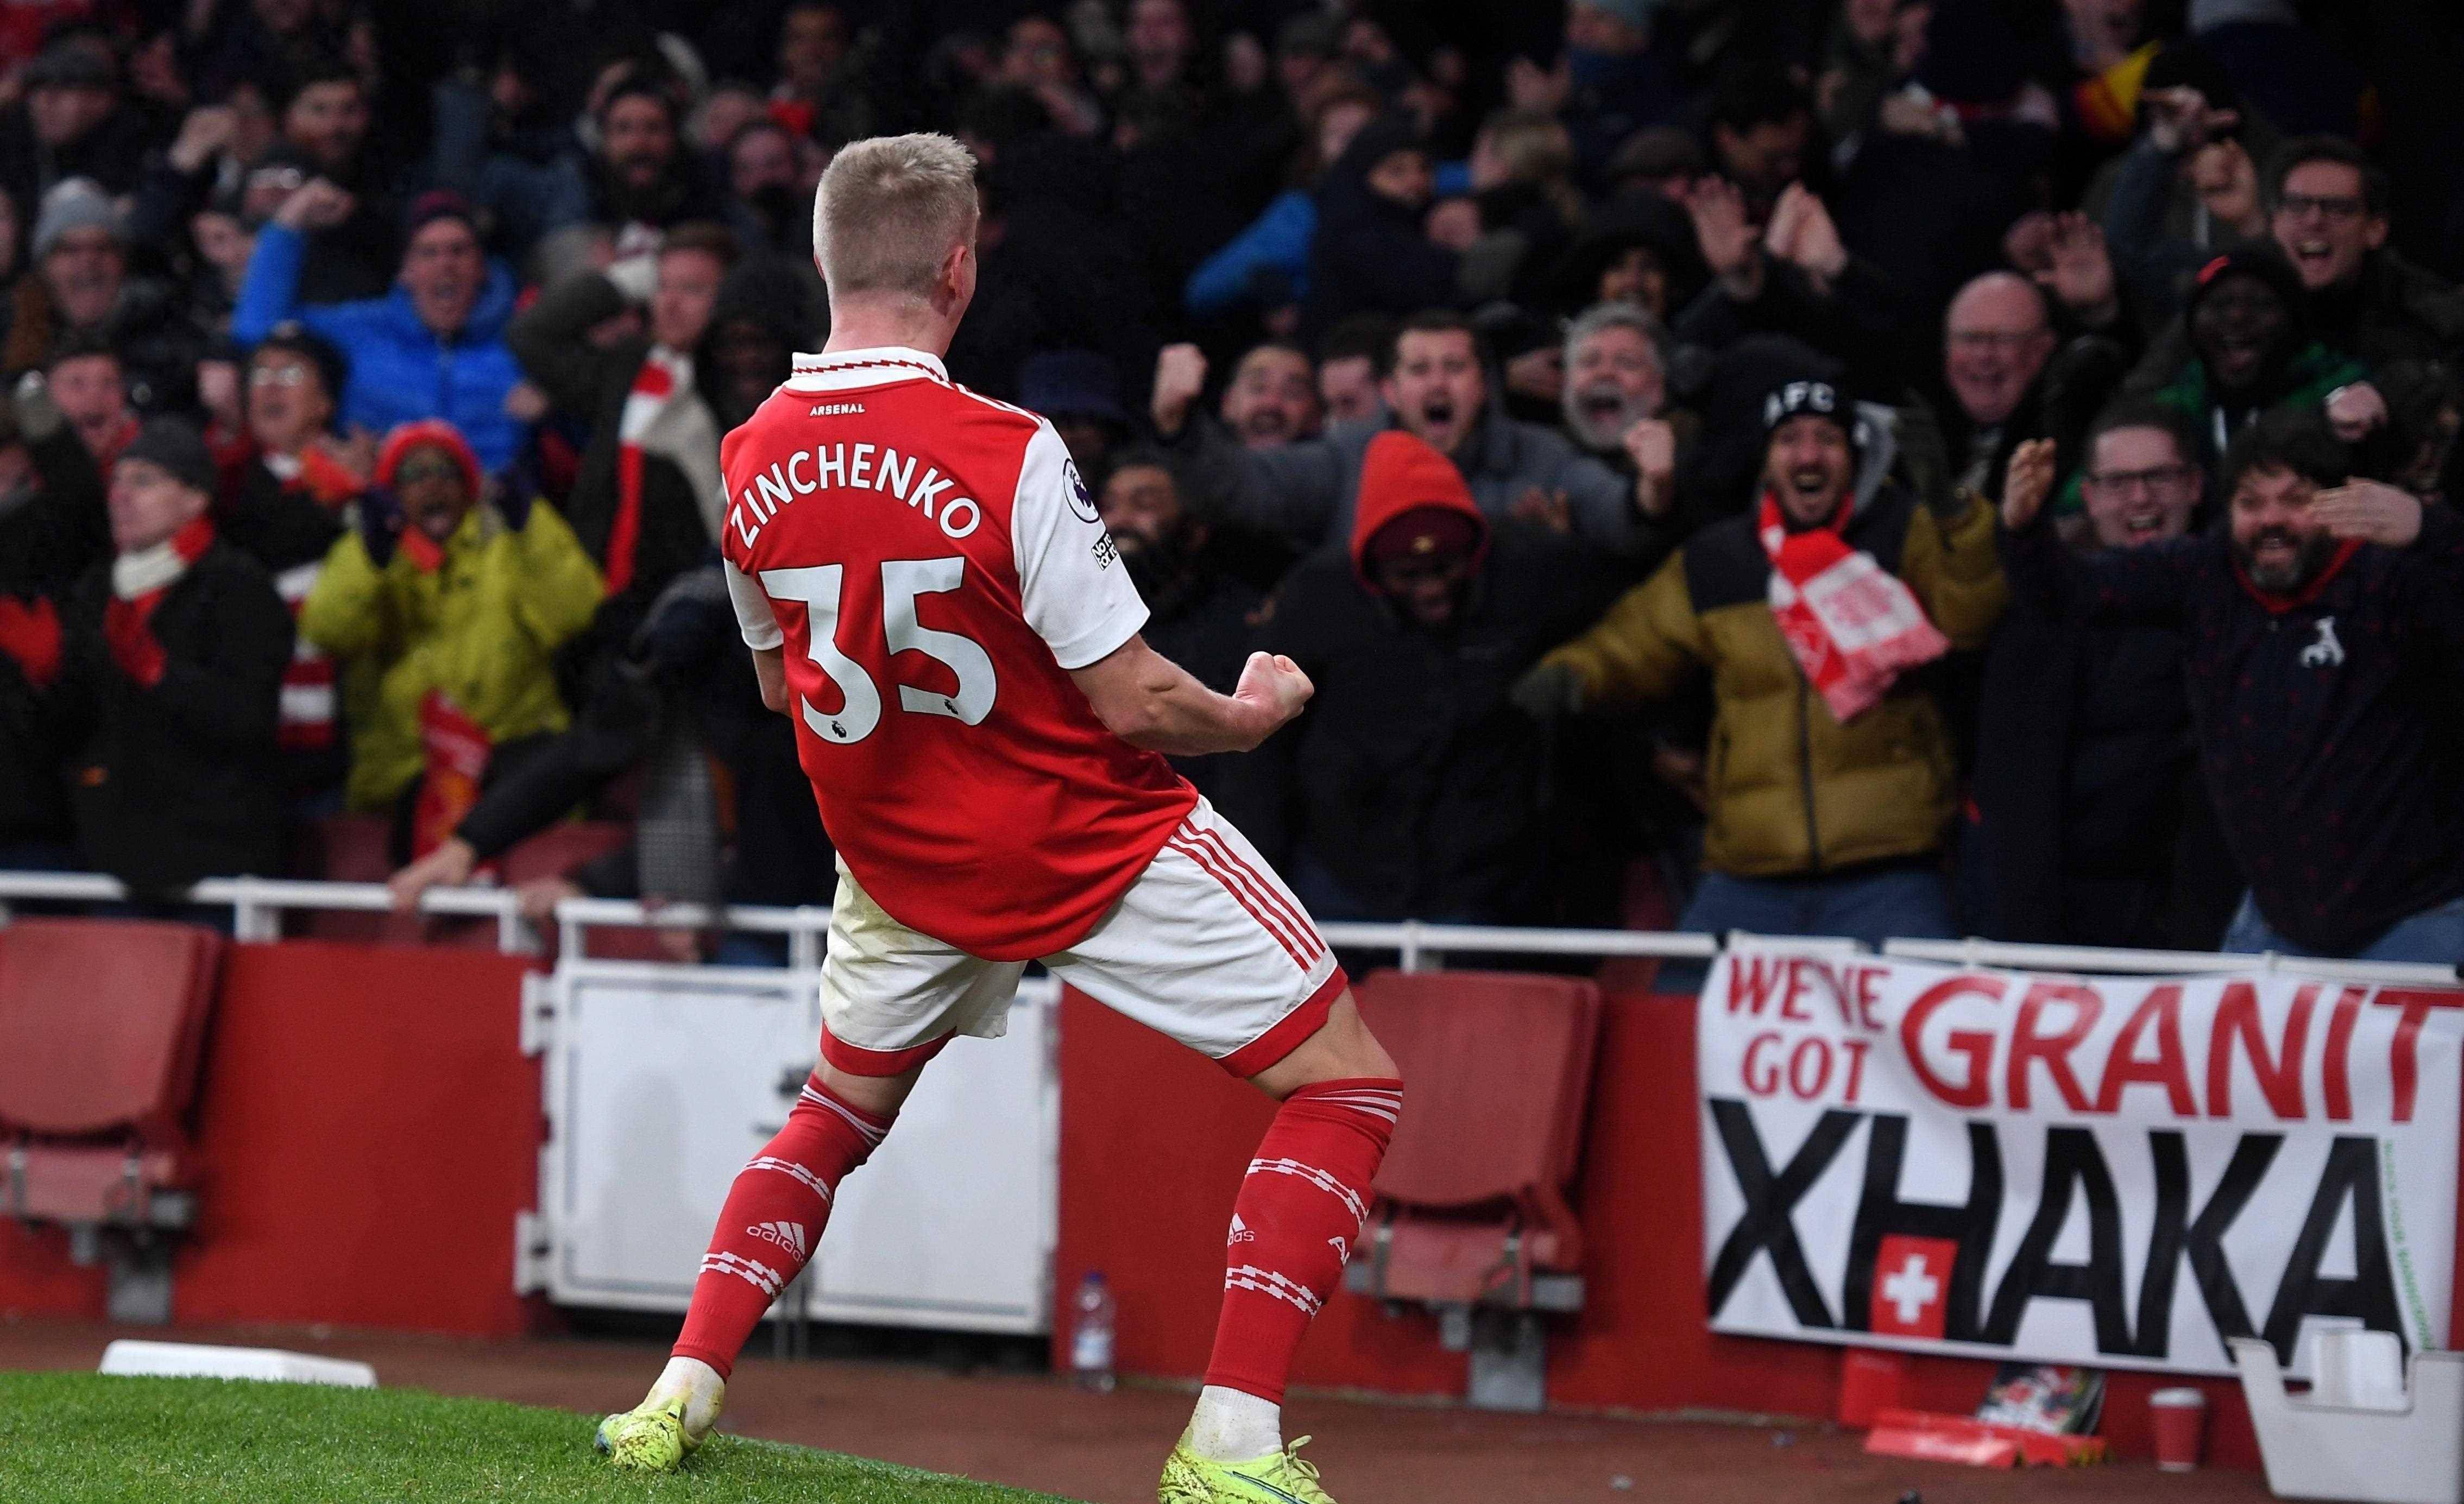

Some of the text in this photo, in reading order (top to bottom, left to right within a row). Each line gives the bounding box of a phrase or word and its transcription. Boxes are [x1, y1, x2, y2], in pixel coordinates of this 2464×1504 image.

[809, 403, 865, 416] ARSENAL
[730, 443, 981, 549] ZINCHENKO
[759, 557, 997, 744] 35
[1742, 1032, 1871, 1104] GOT
[1900, 976, 2464, 1122] GRANIT
[1708, 1098, 2410, 1382] XHAKA
